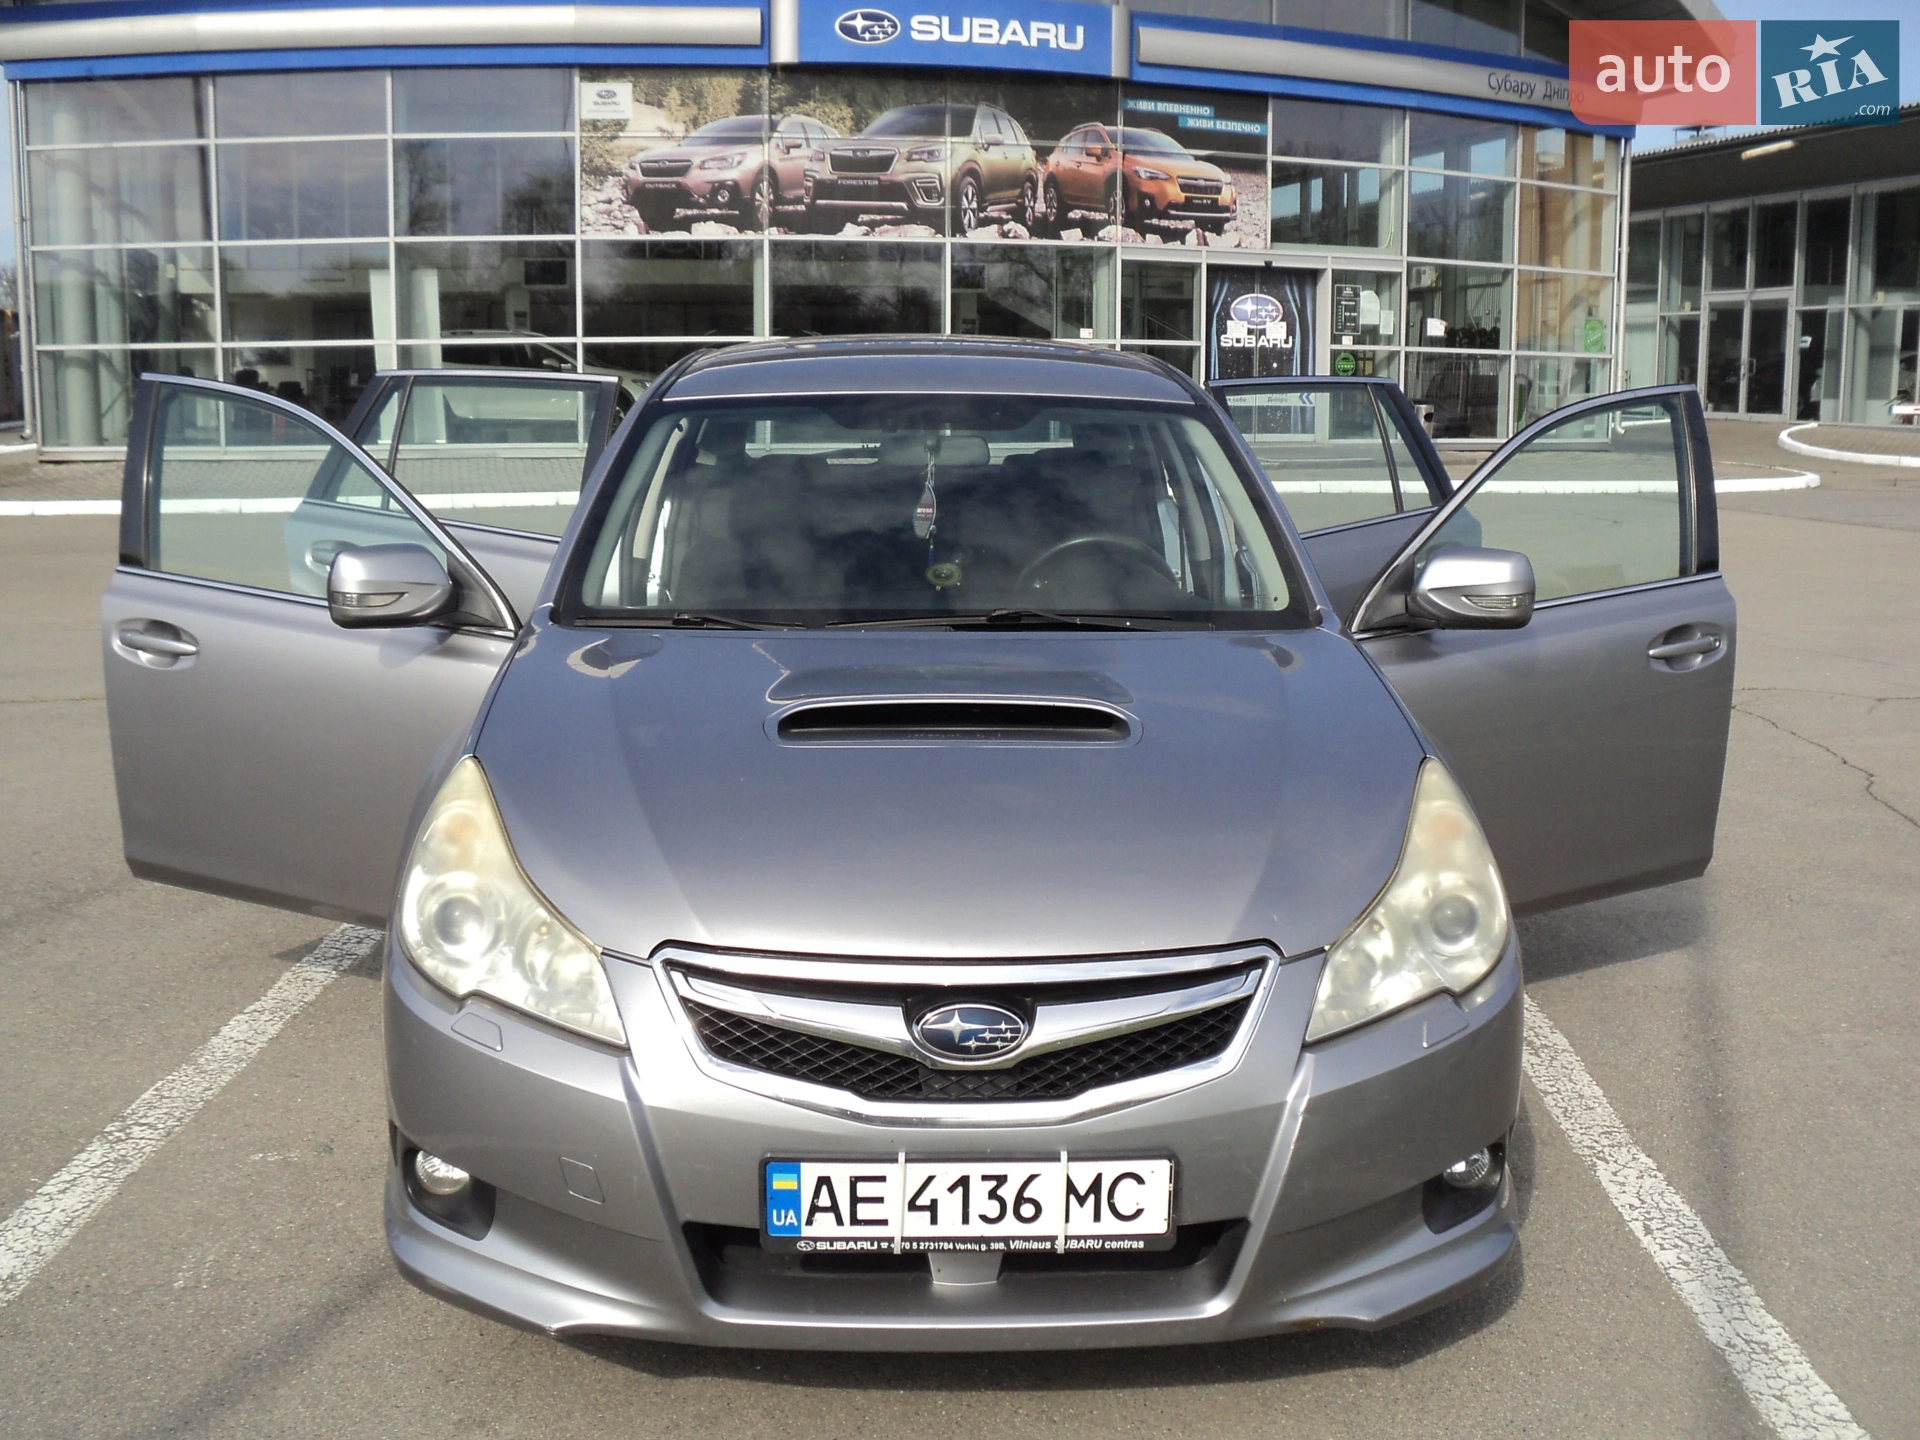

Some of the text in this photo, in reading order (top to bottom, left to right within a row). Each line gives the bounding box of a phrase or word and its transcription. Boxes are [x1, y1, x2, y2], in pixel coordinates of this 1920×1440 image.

[910, 14, 1084, 50] SUBARU
[1488, 72, 1585, 104] Субару Дніпро
[1127, 100, 1210, 115] ЖИВИ ВПЕВНЕННО
[1187, 117, 1261, 133] ЖИВИ БЕЗПЕЧНО
[1220, 335, 1293, 348] SUBARU
[804, 1172, 1146, 1227] AE 4136 MC
[773, 1210, 798, 1226] UA
[816, 1241, 877, 1250] SUBARU
[912, 1242, 918, 1250] 5
[919, 1242, 954, 1250] 2731784
[1009, 1240, 1051, 1249] Vilniaus
[1104, 1240, 1145, 1249] centras
